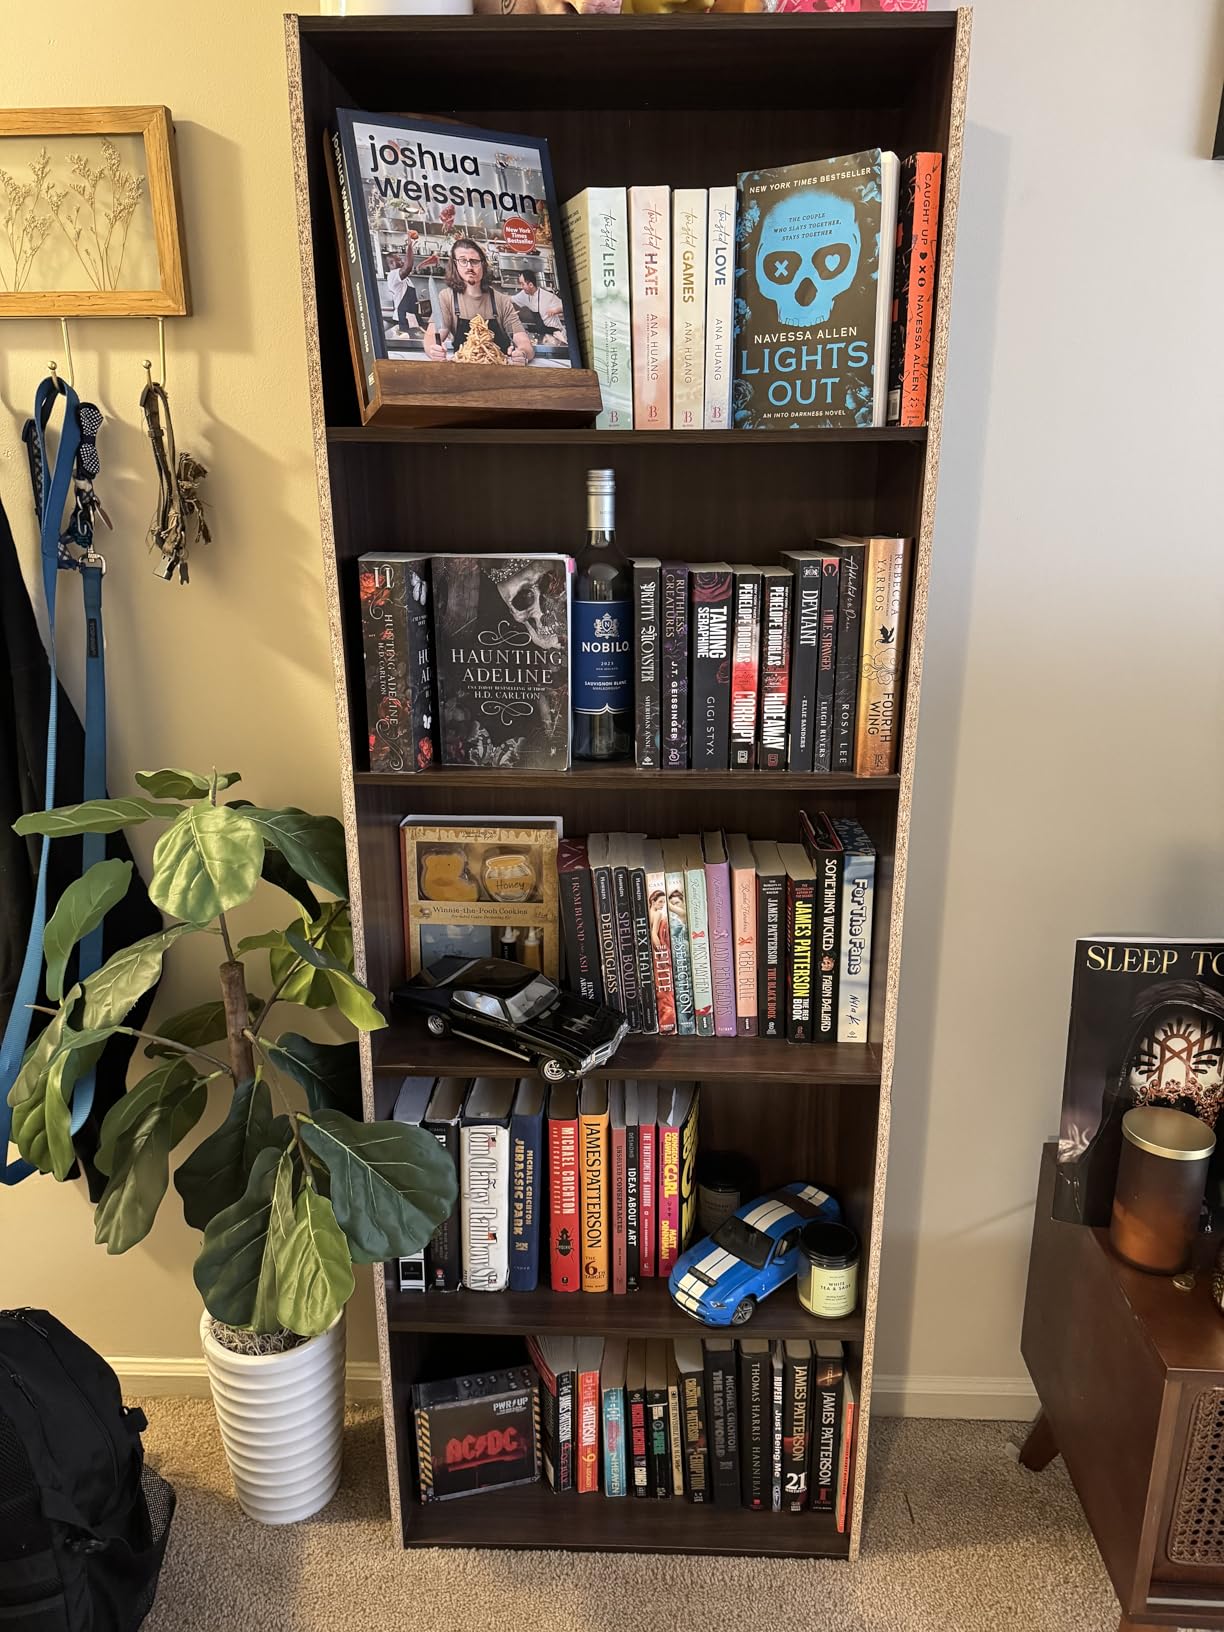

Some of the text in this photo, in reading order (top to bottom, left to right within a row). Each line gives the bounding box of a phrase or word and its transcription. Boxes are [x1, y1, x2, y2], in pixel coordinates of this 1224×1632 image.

[368, 135, 480, 176] joshua
[374, 175, 537, 215] weissman
[750, 167, 871, 194] NEW YORK TIMES BESTSELLER
[802, 213, 825, 221] COUPLE
[921, 174, 931, 245] CAUGHT UP
[802, 230, 832, 238] TOGETHER
[683, 251, 694, 303] GAMES
[715, 248, 726, 286] LOVE
[650, 314, 659, 380] ANA HUANG
[714, 319, 723, 381] ANA HUANG
[754, 327, 857, 343] NAVESSA ALLEN
[912, 295, 924, 391] NAVESSA ALLEN
[741, 340, 868, 374] LIGHTS
[768, 377, 840, 406] OUT
[675, 579, 685, 632] RUTHLESS
[875, 559, 886, 612] YARROS
[891, 554, 903, 616] REBECCA
[665, 574, 675, 638] CREATURES
[736, 584, 753, 663] PENELOPE DOUGLAS
[769, 586, 784, 627] PENELOPE
[800, 590, 818, 646] DEVIANT
[582, 641, 629, 653] NOBILO
[697, 607, 709, 658] SERAPHINE
[709, 606, 727, 658] TAMING
[768, 629, 782, 665] DOUGLAS
[452, 649, 562, 665] HAUNTING
[462, 668, 553, 684] ADELINE
[496, 692, 540, 700] CARLTON
[706, 697, 715, 755] GIGI STYX
[732, 691, 755, 745] CORRUPT
[840, 704, 850, 764] ROSA LEE
[868, 701, 881, 735] WING
[880, 693, 894, 742] FOURTH
[496, 879, 524, 890] Honey
[823, 859, 837, 950] SOMETHING WICKED
[767, 898, 777, 922] JAMES
[794, 901, 812, 935] JAMES
[848, 879, 868, 974] For The Fans
[601, 913, 617, 994] DEMONGLASS
[619, 912, 636, 998] SPELL BOUND
[636, 918, 650, 988] HEX HALL
[767, 924, 777, 964] PATTERSON
[1086, 945, 1178, 975] SLEEP
[654, 951, 671, 992] ELITE
[674, 944, 691, 1014] SELECTION
[693, 943, 709, 993] MISS MAYHEM
[738, 950, 755, 1001] REBEL BELLE
[793, 939, 811, 996] PATTERSON
[767, 968, 776, 1018] THE BLACK BOOK
[792, 999, 802, 1020] BOOK
[820, 975, 833, 1031] FALON BALLARD
[643, 1133, 651, 1141] THE
[664, 1132, 672, 1164] CRAWLER
[670, 1132, 678, 1164] DUNGEON
[561, 1128, 575, 1214] MICHAEL CRICHTON
[642, 1144, 651, 1183] TWENTYSOMETHING
[664, 1164, 678, 1198] CARL
[513, 1138, 524, 1235] JURASSIC PARK
[525, 1186, 533, 1225] CRICHTON
[584, 1123, 602, 1248] JAMES PATTERSON
[463, 1127, 497, 1288] Tom Clancy Rainbow Six
[628, 1168, 636, 1246] IDEAS ABOUT ART
[661, 1220, 670, 1259] DINNIMAN
[668, 1229, 677, 1249] MATT
[752, 1363, 760, 1402] THOMAS
[582, 1407, 596, 1446] PATTERSON
[685, 1379, 699, 1441] CRICHTON PATTERSON
[752, 1405, 760, 1441] HARRIS
[773, 1376, 783, 1477] RUPERT Just Being Me
[792, 1365, 807, 1461] JAMES PATTERSON
[821, 1392, 836, 1424] JAMES
[446, 1427, 518, 1463] AC/DC
[818, 1427, 835, 1485] PATTERSON
[611, 1462, 620, 1494] HEAVEN
[689, 1455, 704, 1491] ERUPTION
[785, 1472, 807, 1490] 21
